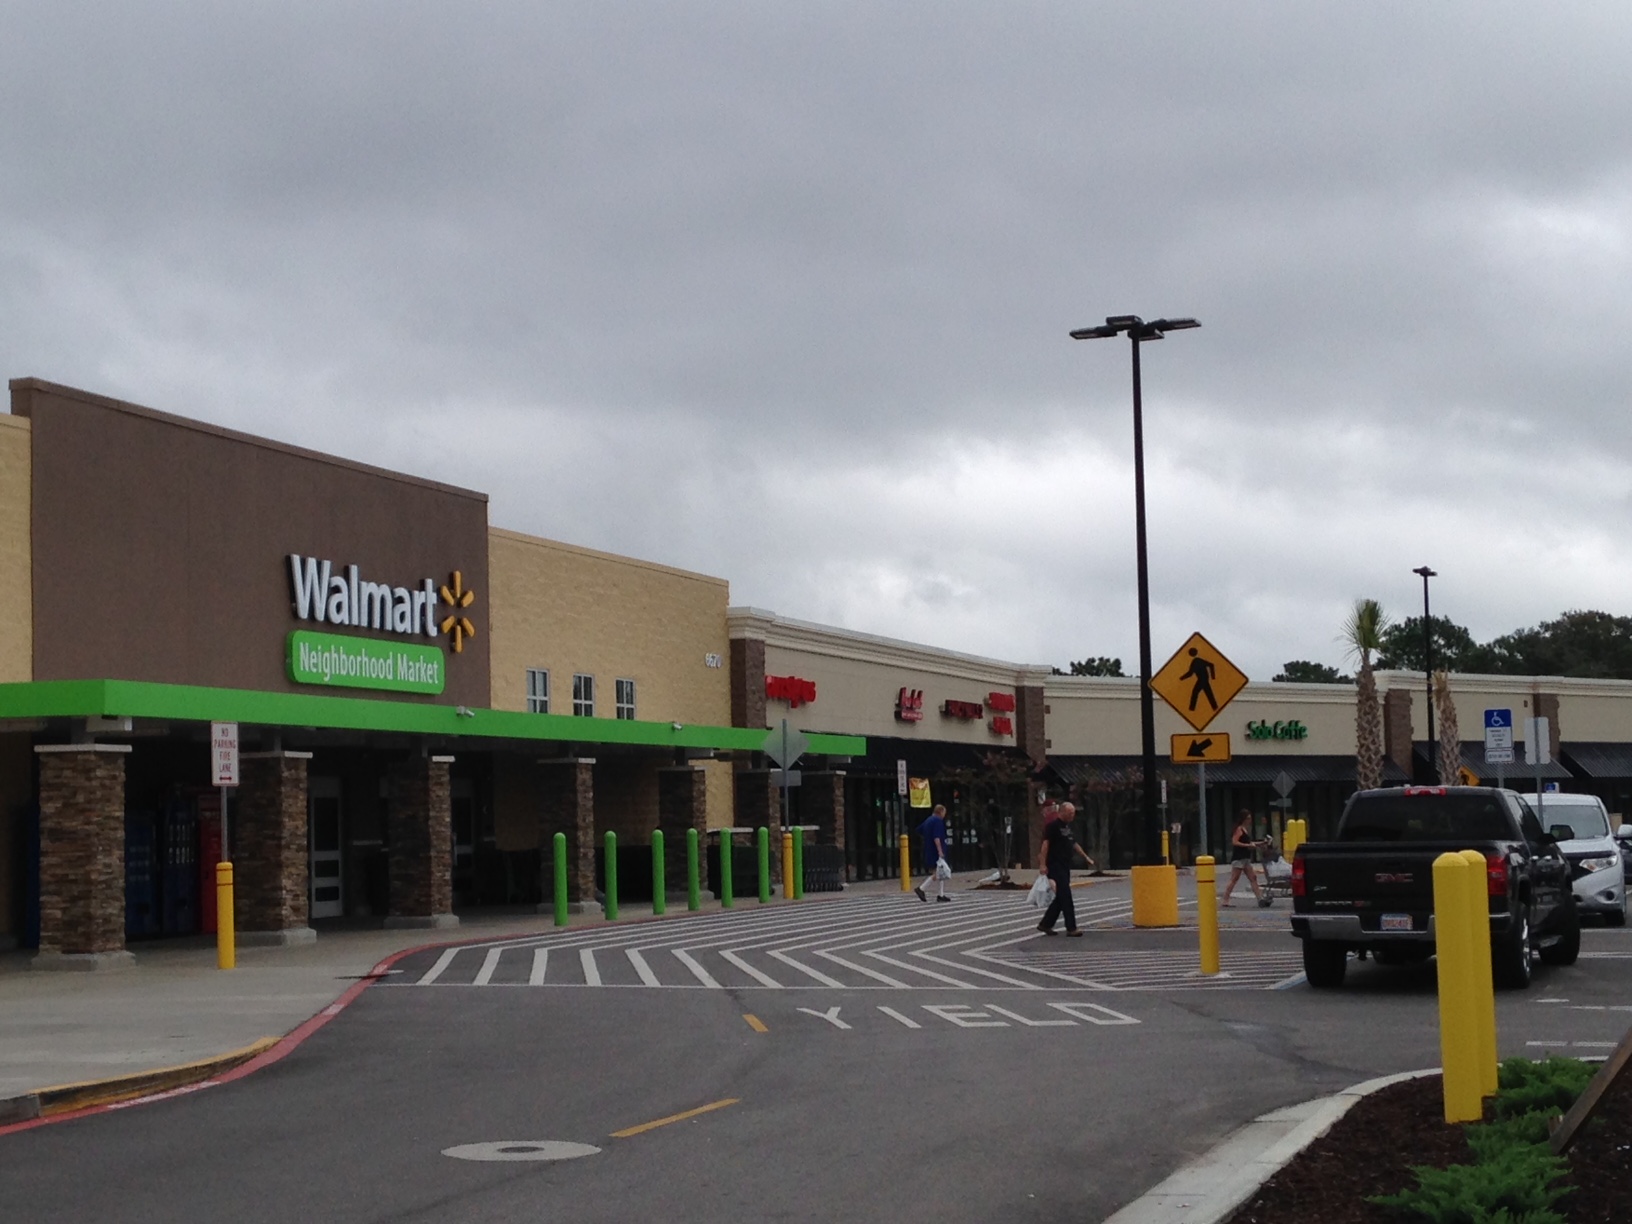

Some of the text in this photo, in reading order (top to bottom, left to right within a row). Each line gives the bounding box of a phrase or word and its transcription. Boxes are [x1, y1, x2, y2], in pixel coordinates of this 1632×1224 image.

[288, 553, 438, 637] Walmart
[300, 641, 439, 684] Neighborhood Market
[221, 727, 229, 737] NO
[213, 739, 236, 749] PARKING
[219, 751, 231, 761] FIRE
[219, 763, 232, 772] LANE
[1375, 873, 1414, 882] GMC
[796, 1002, 1142, 1029] YIELD
